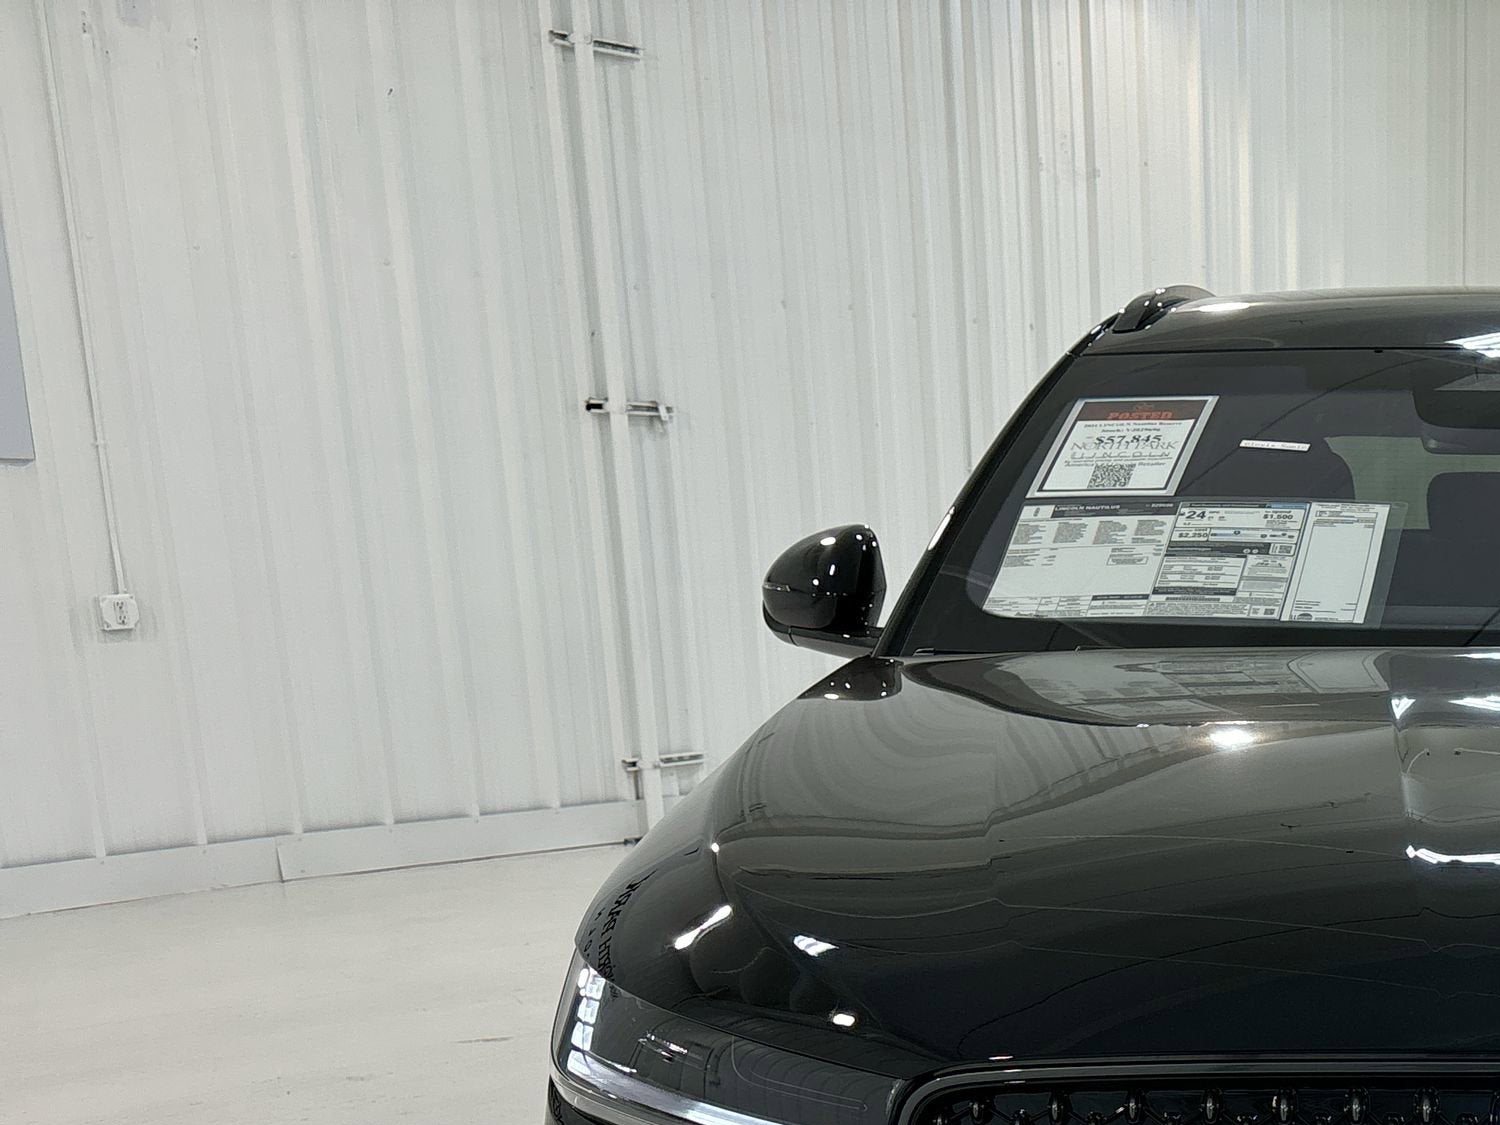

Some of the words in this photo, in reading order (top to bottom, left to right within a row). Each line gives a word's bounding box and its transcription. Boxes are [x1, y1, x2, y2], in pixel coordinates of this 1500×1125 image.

[1106, 410, 1173, 420] POSTED
[1095, 434, 1162, 445] $57,845
[1185, 510, 1207, 520] 24
